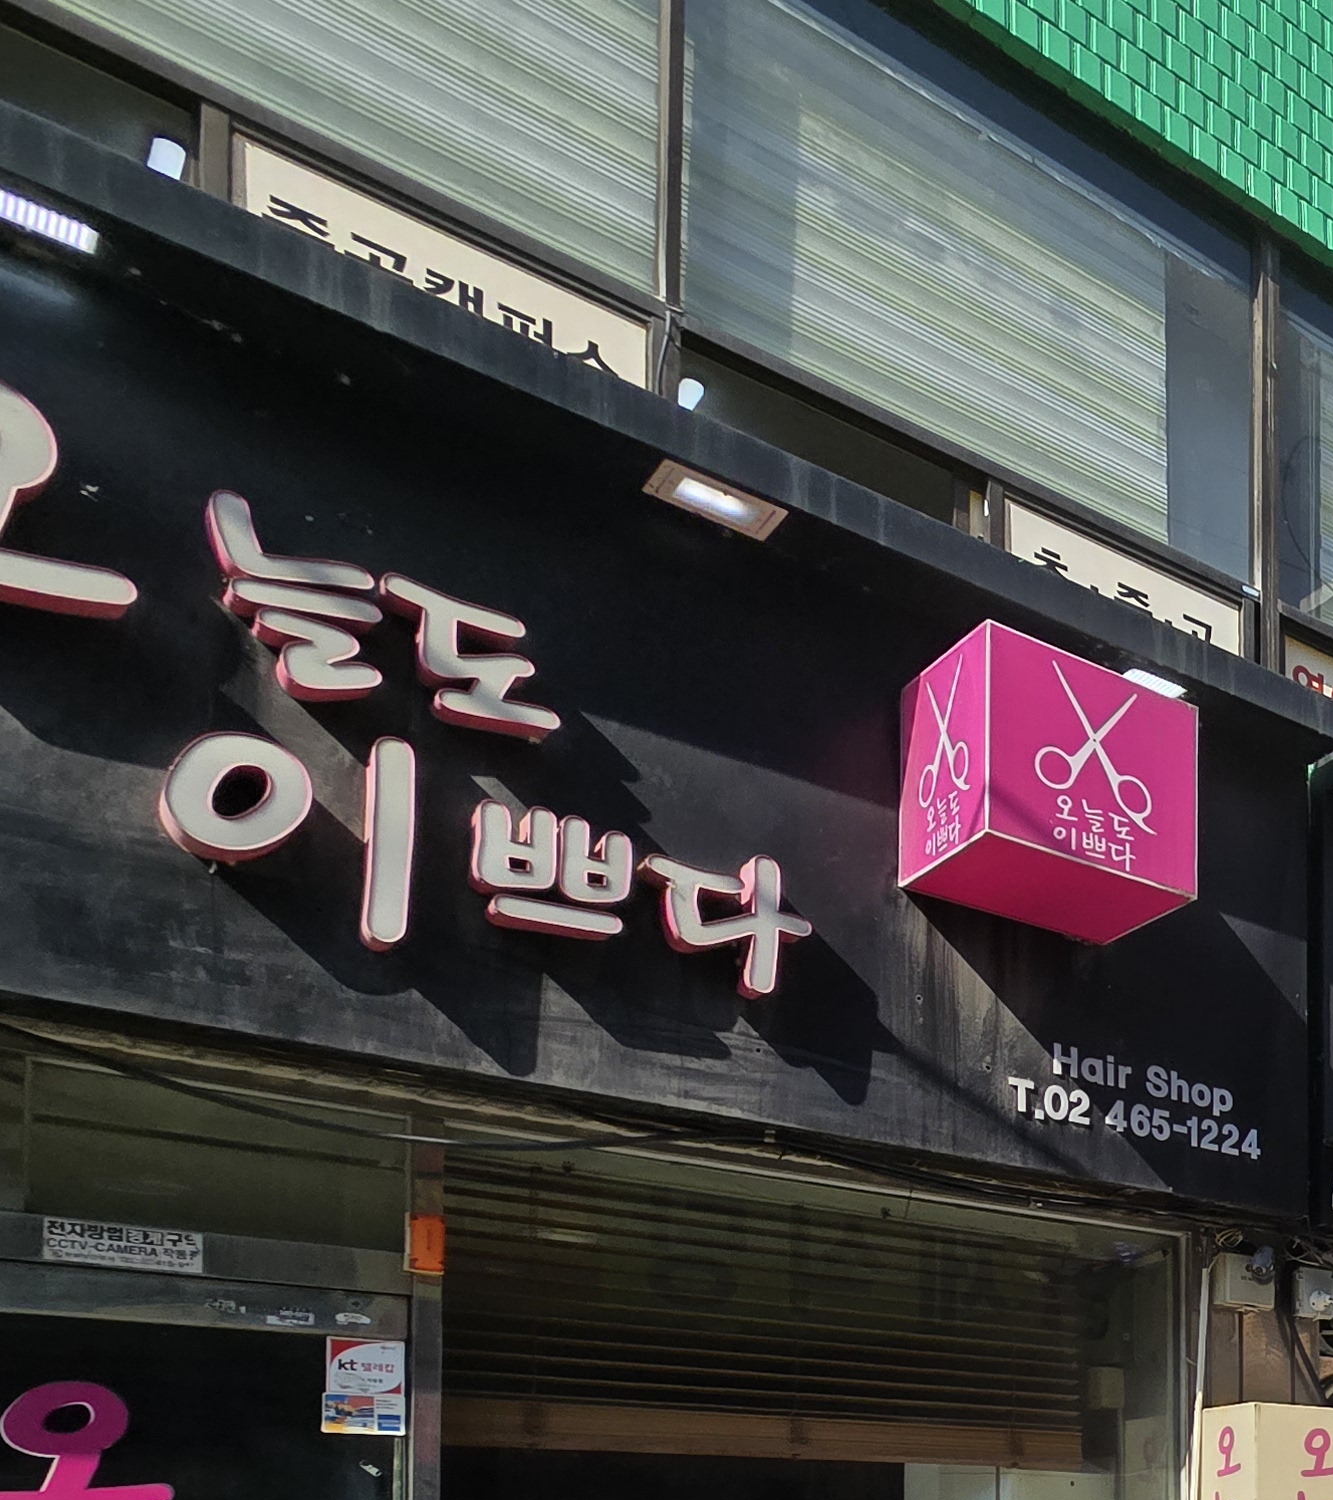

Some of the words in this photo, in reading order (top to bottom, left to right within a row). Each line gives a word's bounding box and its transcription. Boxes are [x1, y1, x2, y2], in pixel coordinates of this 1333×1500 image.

[927, 790, 960, 832] 오늘도
[1055, 794, 1135, 840] 오늘도
[925, 820, 962, 856] 이쁘다
[1053, 826, 1136, 871] 이쁘다
[160, 731, 812, 997] 이쁘다
[1053, 1042, 1132, 1089] Hair
[1145, 1065, 1233, 1117] Shop
[1008, 1076, 1091, 1125] T.02
[1105, 1100, 1261, 1160] 465-1224
[337, 1359, 358, 1371] kt
